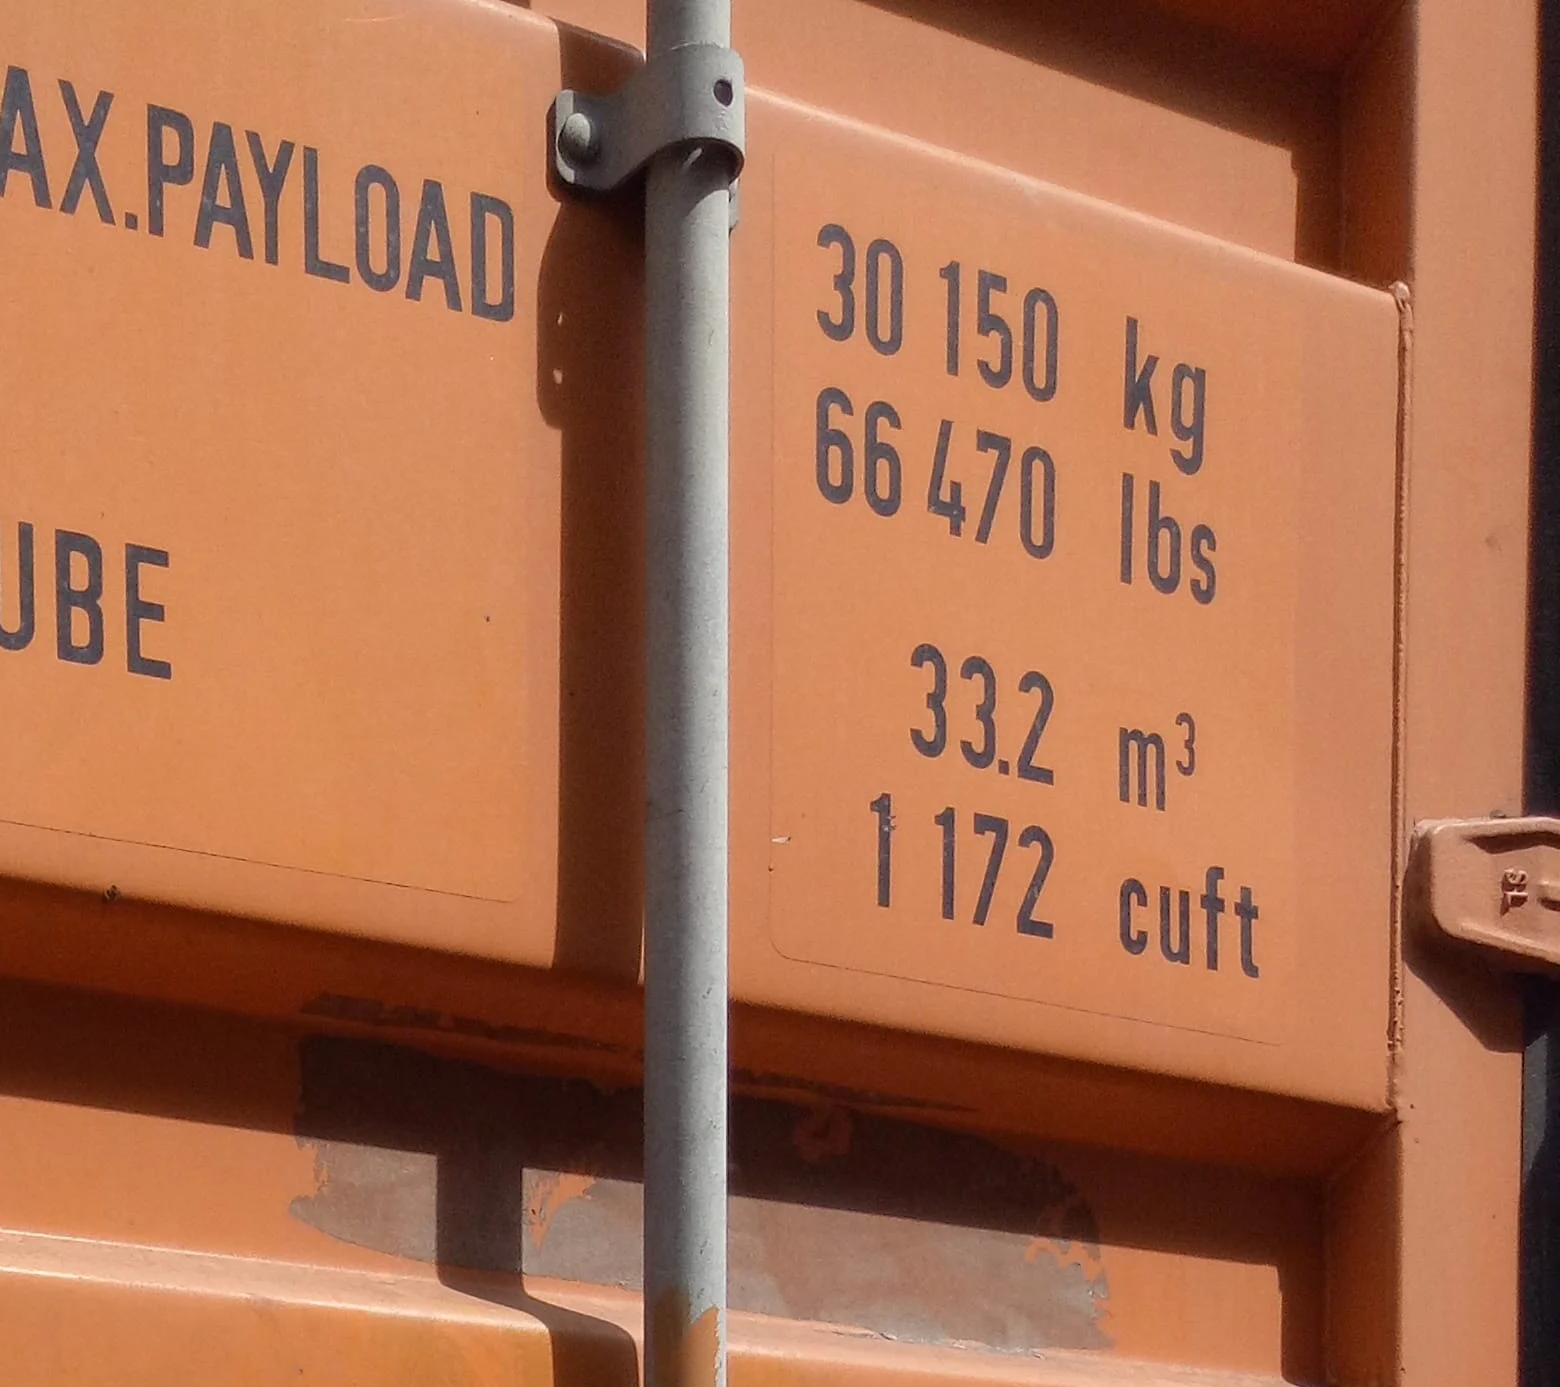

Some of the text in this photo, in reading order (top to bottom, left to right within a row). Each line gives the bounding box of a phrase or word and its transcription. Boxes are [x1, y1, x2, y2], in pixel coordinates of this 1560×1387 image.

[1122, 314, 1207, 476] kg
[1120, 471, 1217, 605] lbs
[909, 642, 1055, 786] 33.2
[1119, 865, 1261, 979] cuft
